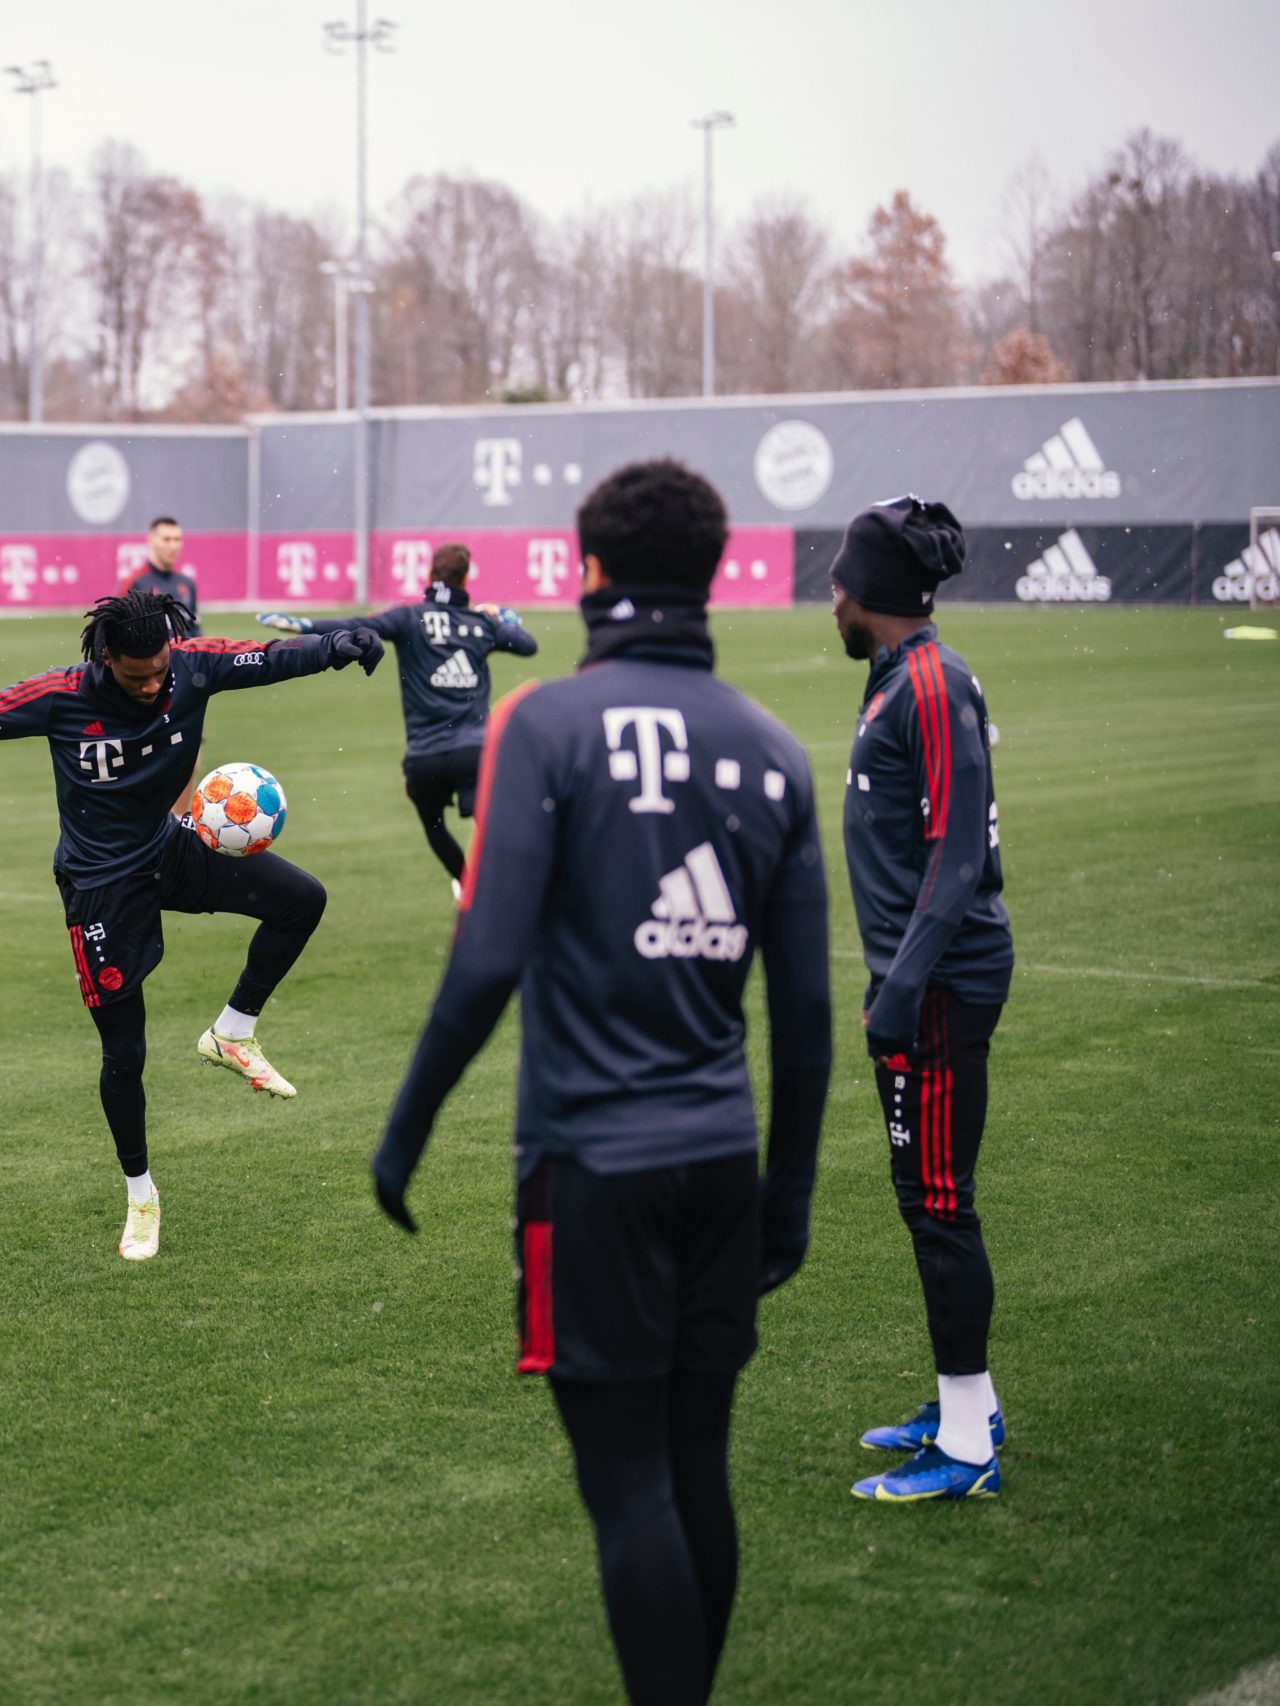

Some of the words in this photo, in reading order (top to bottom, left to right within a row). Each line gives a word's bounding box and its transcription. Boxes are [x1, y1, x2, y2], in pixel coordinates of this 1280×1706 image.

[1011, 470, 1121, 500] adidas
[1015, 574, 1112, 602] adidas
[163, 713, 170, 723] 3
[634, 918, 749, 962] adas
